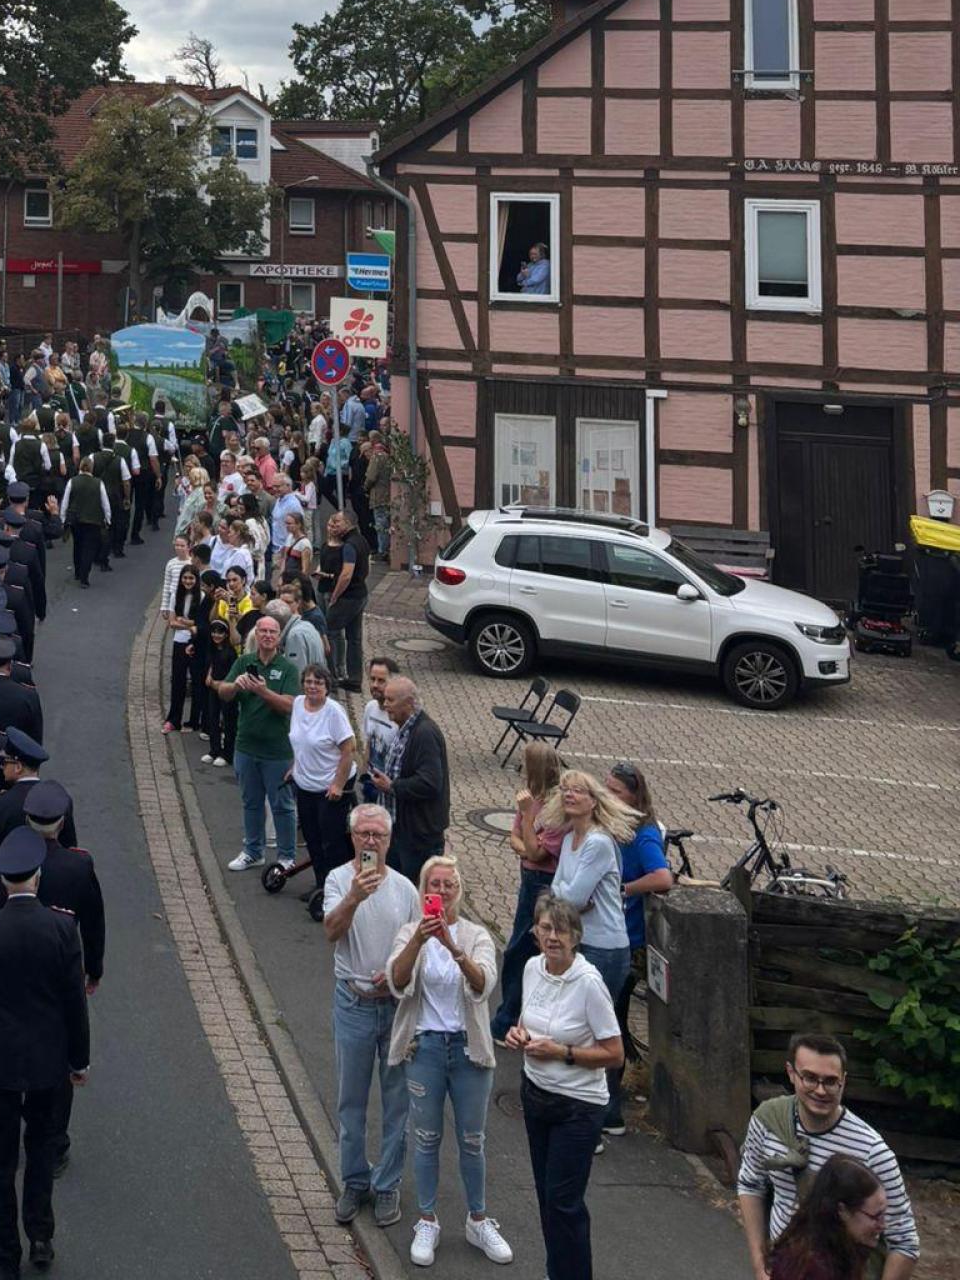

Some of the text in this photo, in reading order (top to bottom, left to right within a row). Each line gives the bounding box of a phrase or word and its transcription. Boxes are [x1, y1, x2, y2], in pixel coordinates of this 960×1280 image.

[856, 162, 882, 174] 1848
[253, 265, 337, 276] APOTHEKE
[336, 335, 381, 350] OTTO
